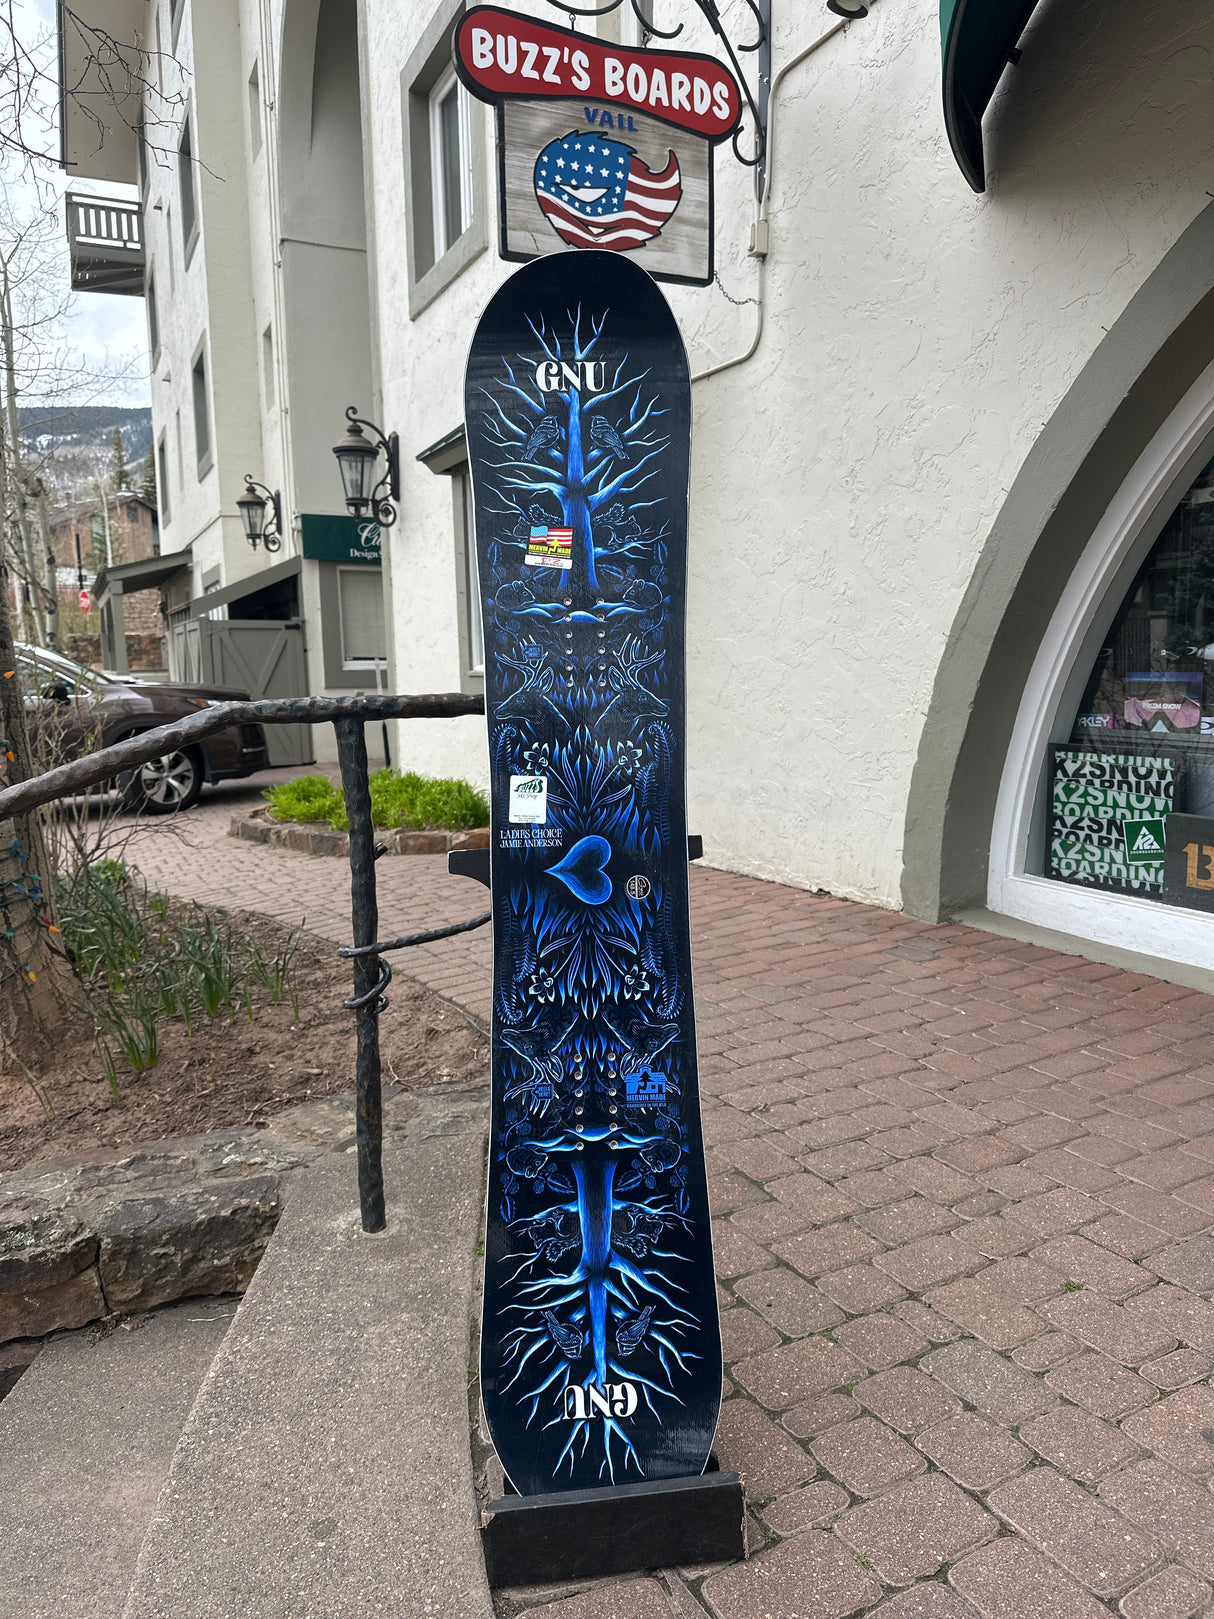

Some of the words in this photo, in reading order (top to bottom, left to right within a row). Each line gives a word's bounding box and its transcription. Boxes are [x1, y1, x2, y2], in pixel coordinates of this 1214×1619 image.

[471, 28, 591, 91] BUZZ'S
[604, 57, 731, 120] BOARDS
[584, 107, 638, 132] VAIL
[535, 360, 607, 392] GNU
[349, 548, 378, 560] Design
[528, 544, 549, 553] MERVIN
[1078, 716, 1111, 728] AKLEY
[1053, 802, 1168, 820] BOARDIN
[500, 829, 531, 840] LADIES
[531, 828, 563, 839] CHOICE
[499, 839, 523, 848] JAMIE
[523, 838, 563, 848] ANDERSON
[1132, 833, 1160, 851] K2
[626, 1094, 649, 1102] MERVIN
[649, 1093, 666, 1101] MADE
[561, 1381, 639, 1421] GNU
